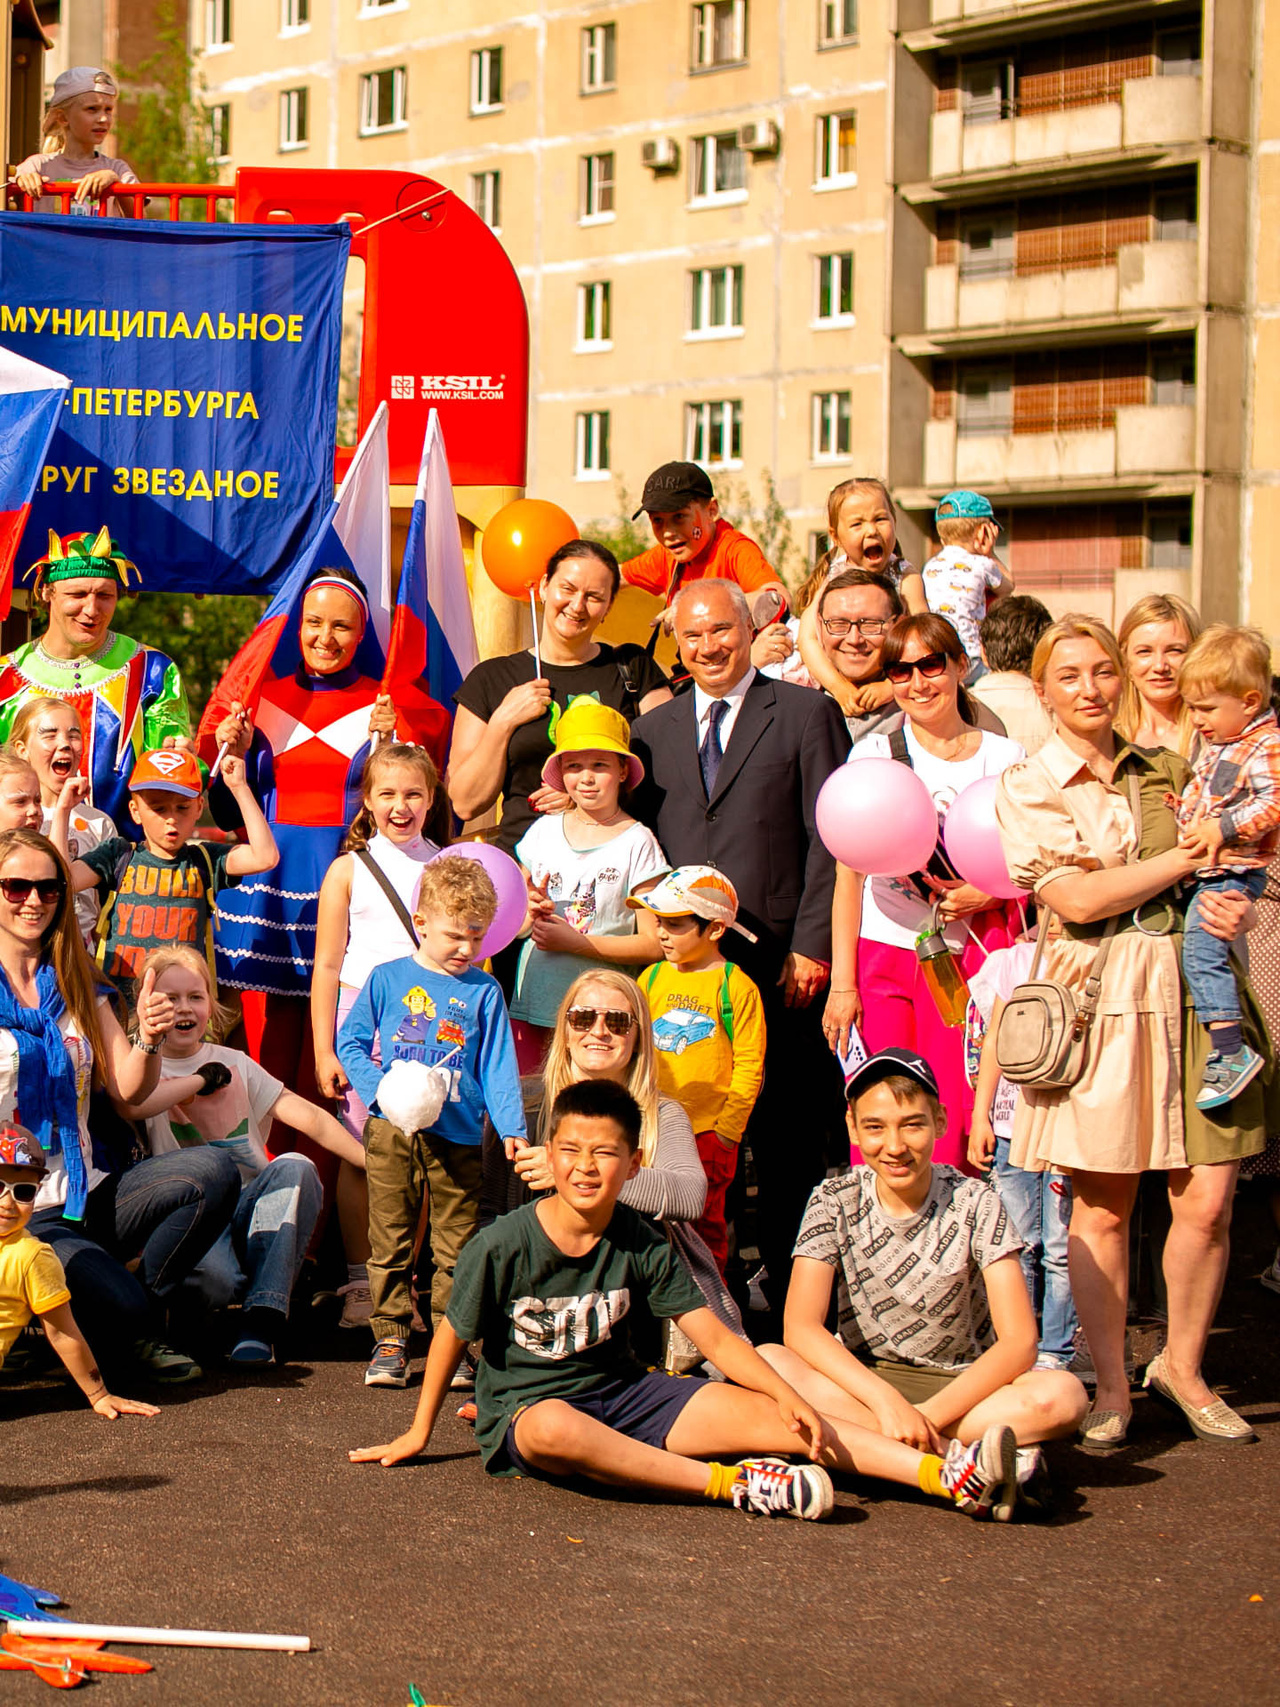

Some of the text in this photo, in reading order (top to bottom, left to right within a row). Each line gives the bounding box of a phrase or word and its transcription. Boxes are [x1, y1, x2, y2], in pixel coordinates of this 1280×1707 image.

[1, 305, 303, 342] МУНИЦИПАЛЬНОЕ
[421, 376, 503, 390] KSIL
[421, 391, 504, 400] WWW.KSIL.COM
[37, 466, 279, 501] РУГ ЗВЕЗДНОЕ
[119, 865, 204, 898] BUILD
[117, 903, 198, 941] YOUR
[667, 993, 699, 1004] DRAG
[677, 1003, 713, 1015] DRIFT
[932, 1223, 958, 1263] caldwell
[945, 1234, 967, 1274] caldwell
[887, 1254, 919, 1287] caldwell
[928, 1283, 963, 1315] caldwell
[892, 1321, 926, 1345] caldwell
